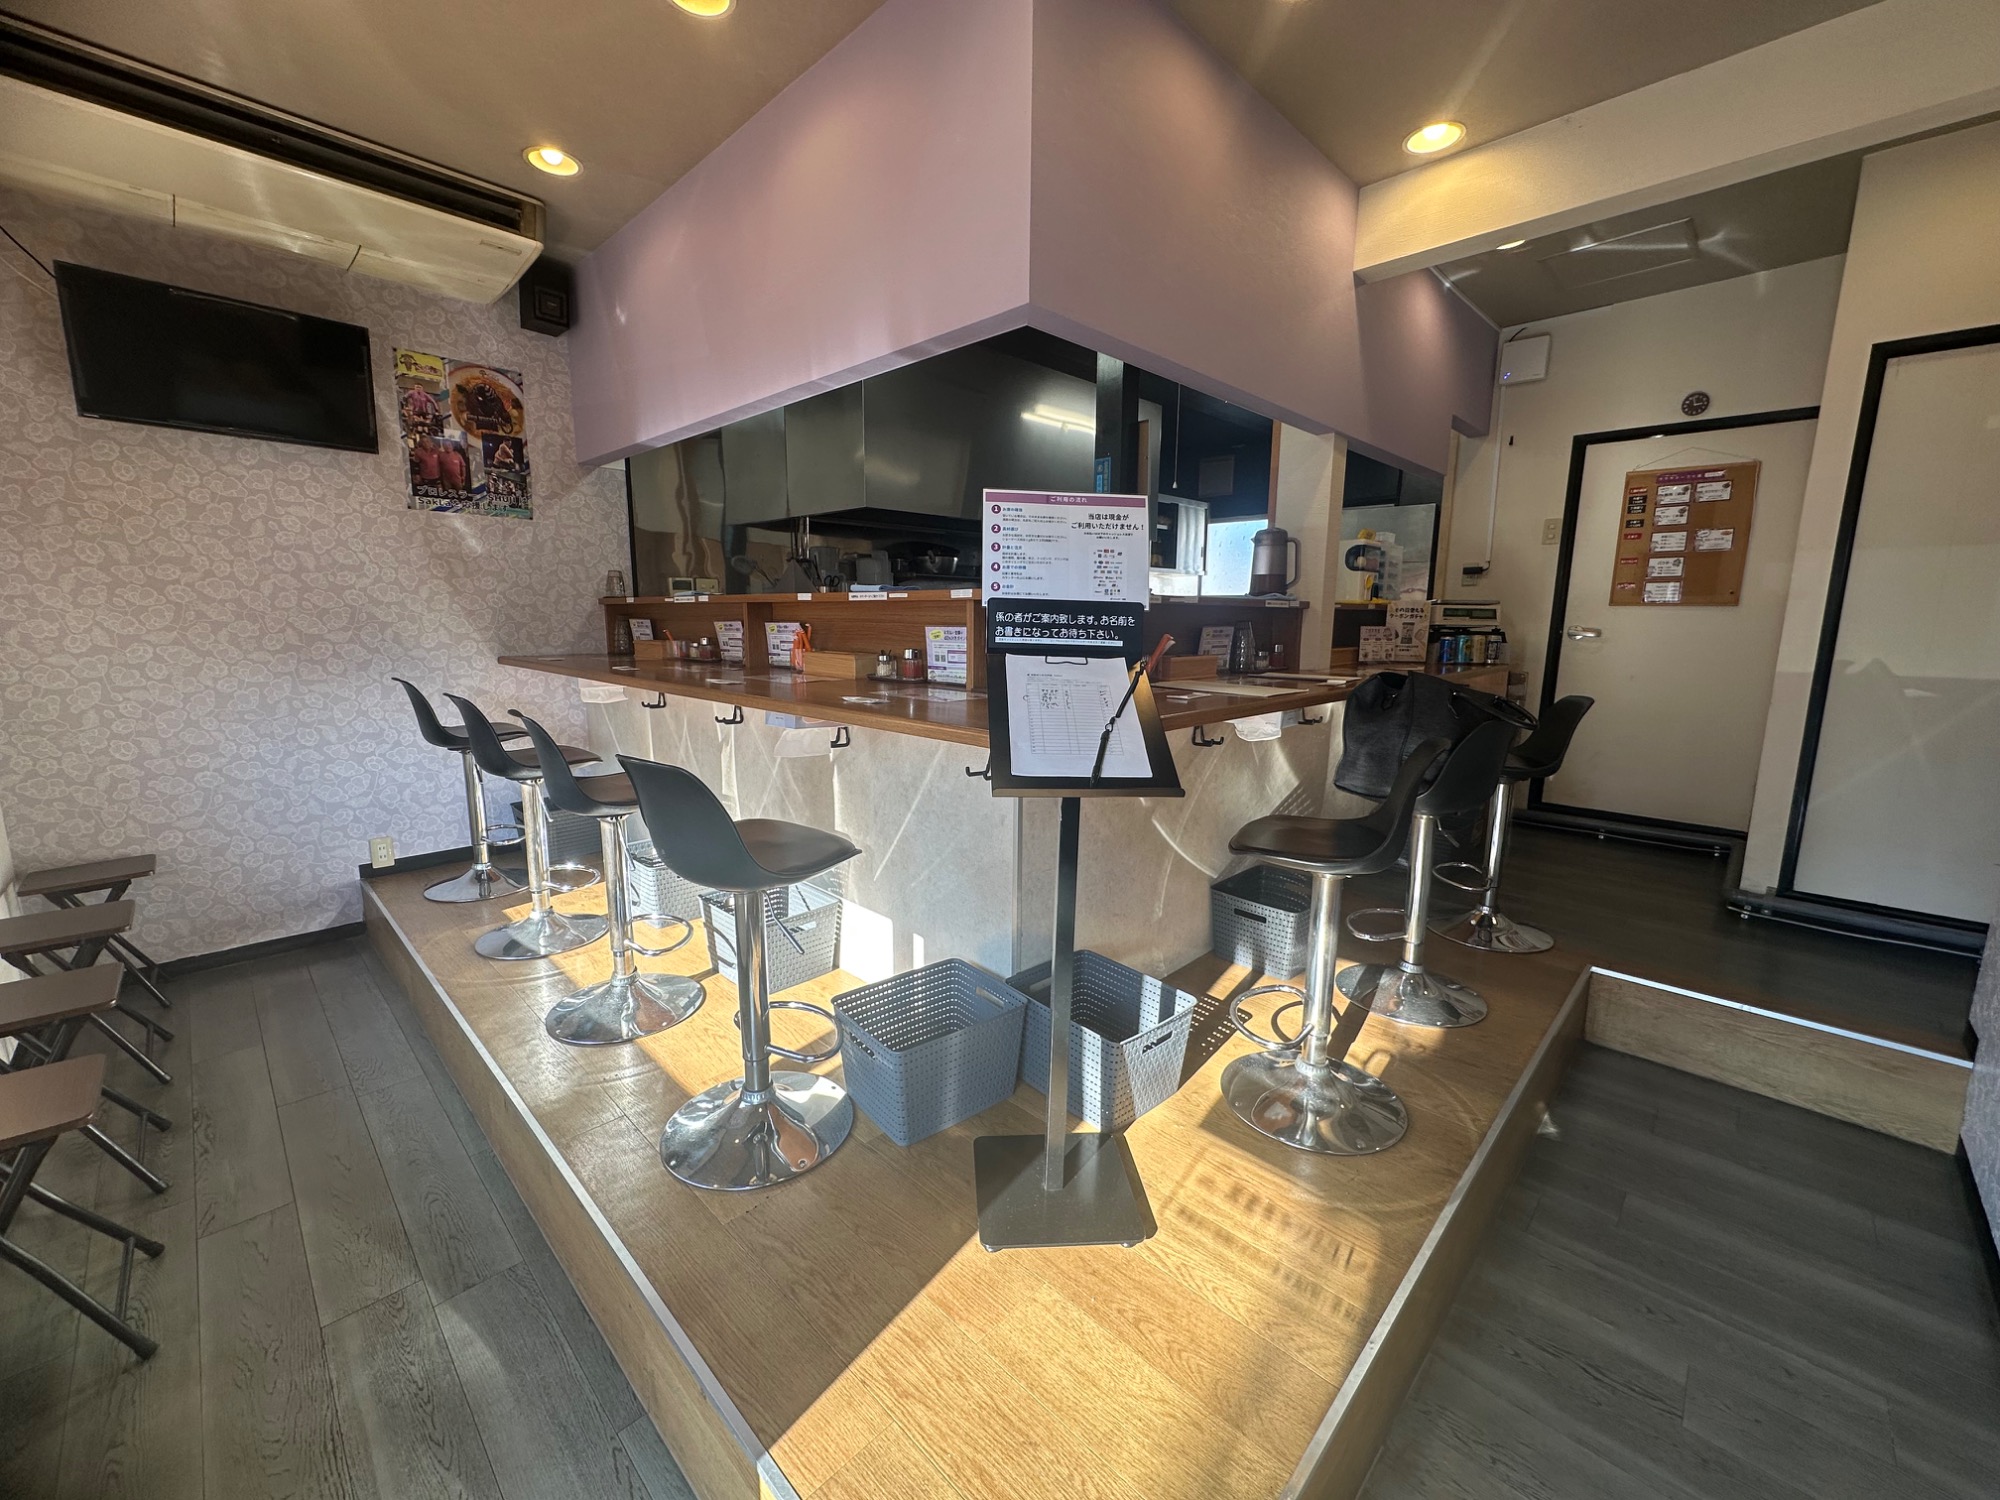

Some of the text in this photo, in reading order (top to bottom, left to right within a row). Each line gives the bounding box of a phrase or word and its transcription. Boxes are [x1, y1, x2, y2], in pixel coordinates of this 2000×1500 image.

[417, 485, 478, 499] プロレスラー
[1088, 513, 1130, 521] 当店は現金が
[1071, 522, 1145, 531] ご利用いただけません！
[995, 612, 1136, 626] 係の者がご案内致します。お名前を
[994, 626, 1119, 640] お書きになってお待ち下さい。
